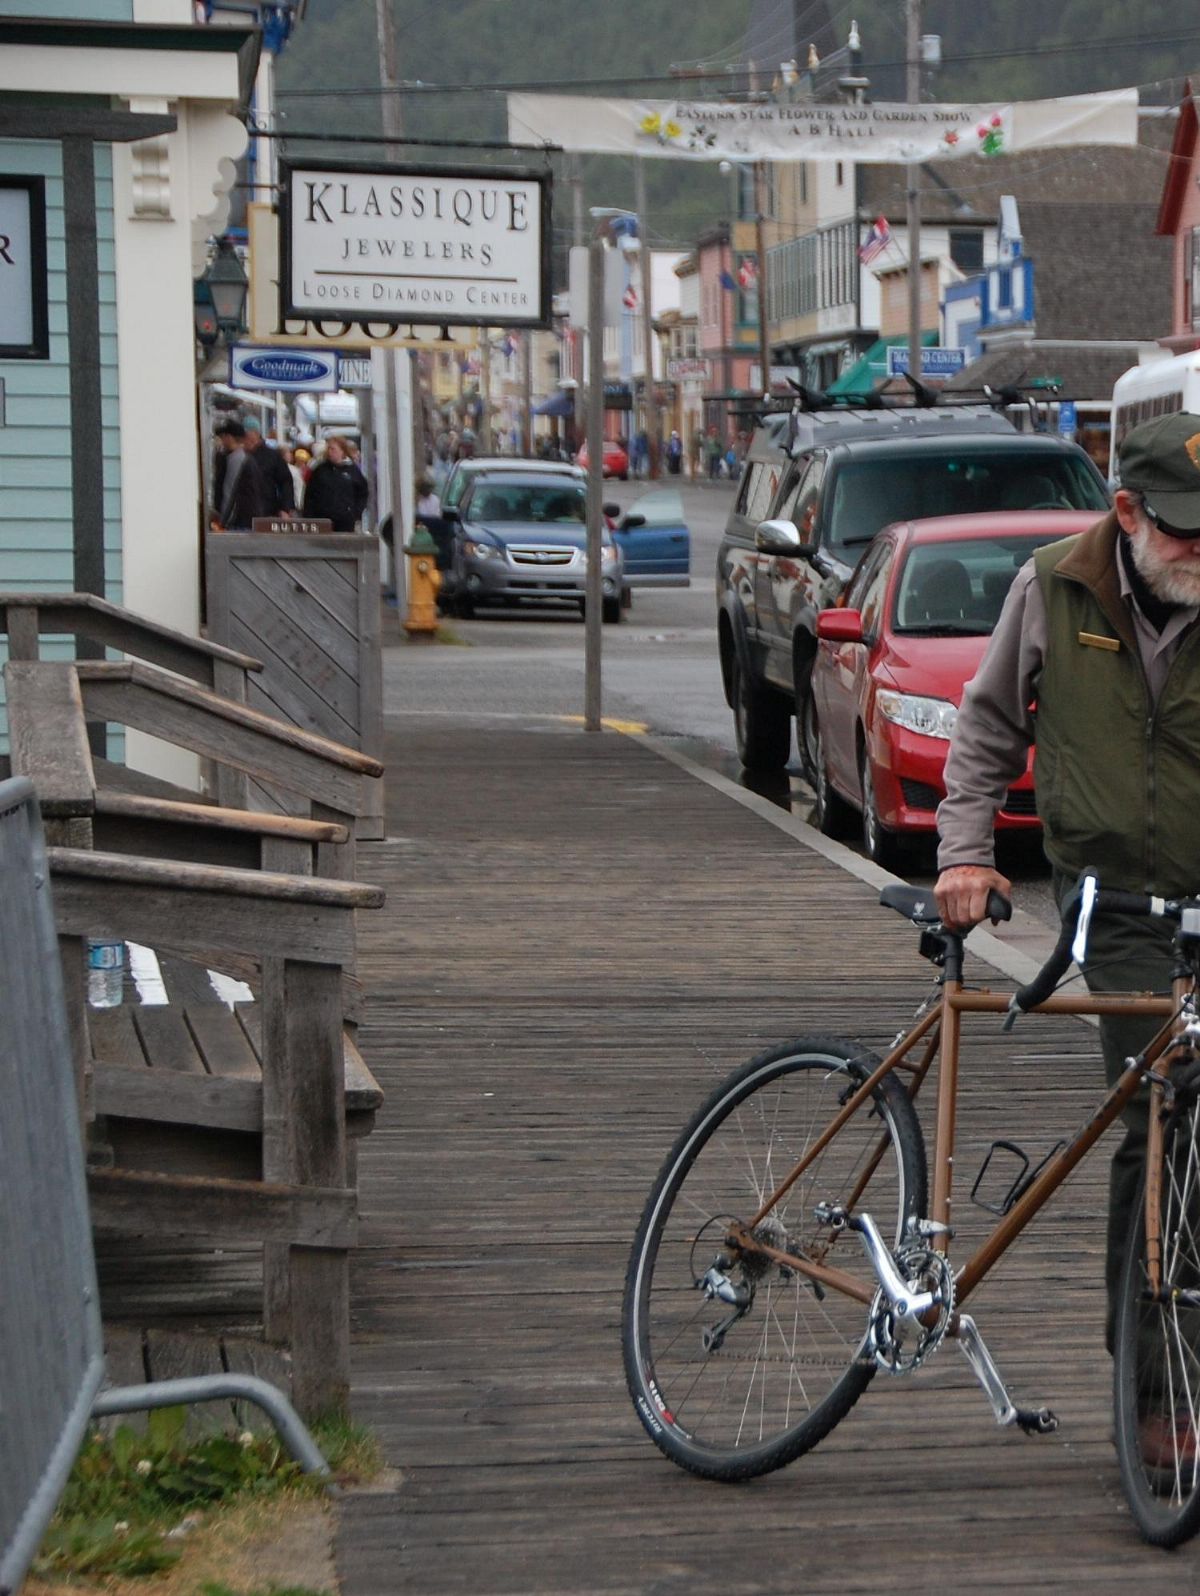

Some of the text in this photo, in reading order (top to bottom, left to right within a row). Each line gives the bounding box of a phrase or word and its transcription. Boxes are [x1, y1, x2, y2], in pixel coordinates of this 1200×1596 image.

[740, 110, 774, 121] STAR
[779, 109, 835, 121] FLOWER
[841, 109, 868, 121] AND
[873, 109, 928, 122] GARDEN
[932, 110, 973, 123] SHOW
[788, 123, 876, 137] A B HALL
[303, 181, 528, 231] KLASSIQUE
[341, 238, 492, 266] JEWELERS
[303, 280, 528, 305] LOOSE DIAMOND CENTER
[252, 357, 319, 373] Goodmark
